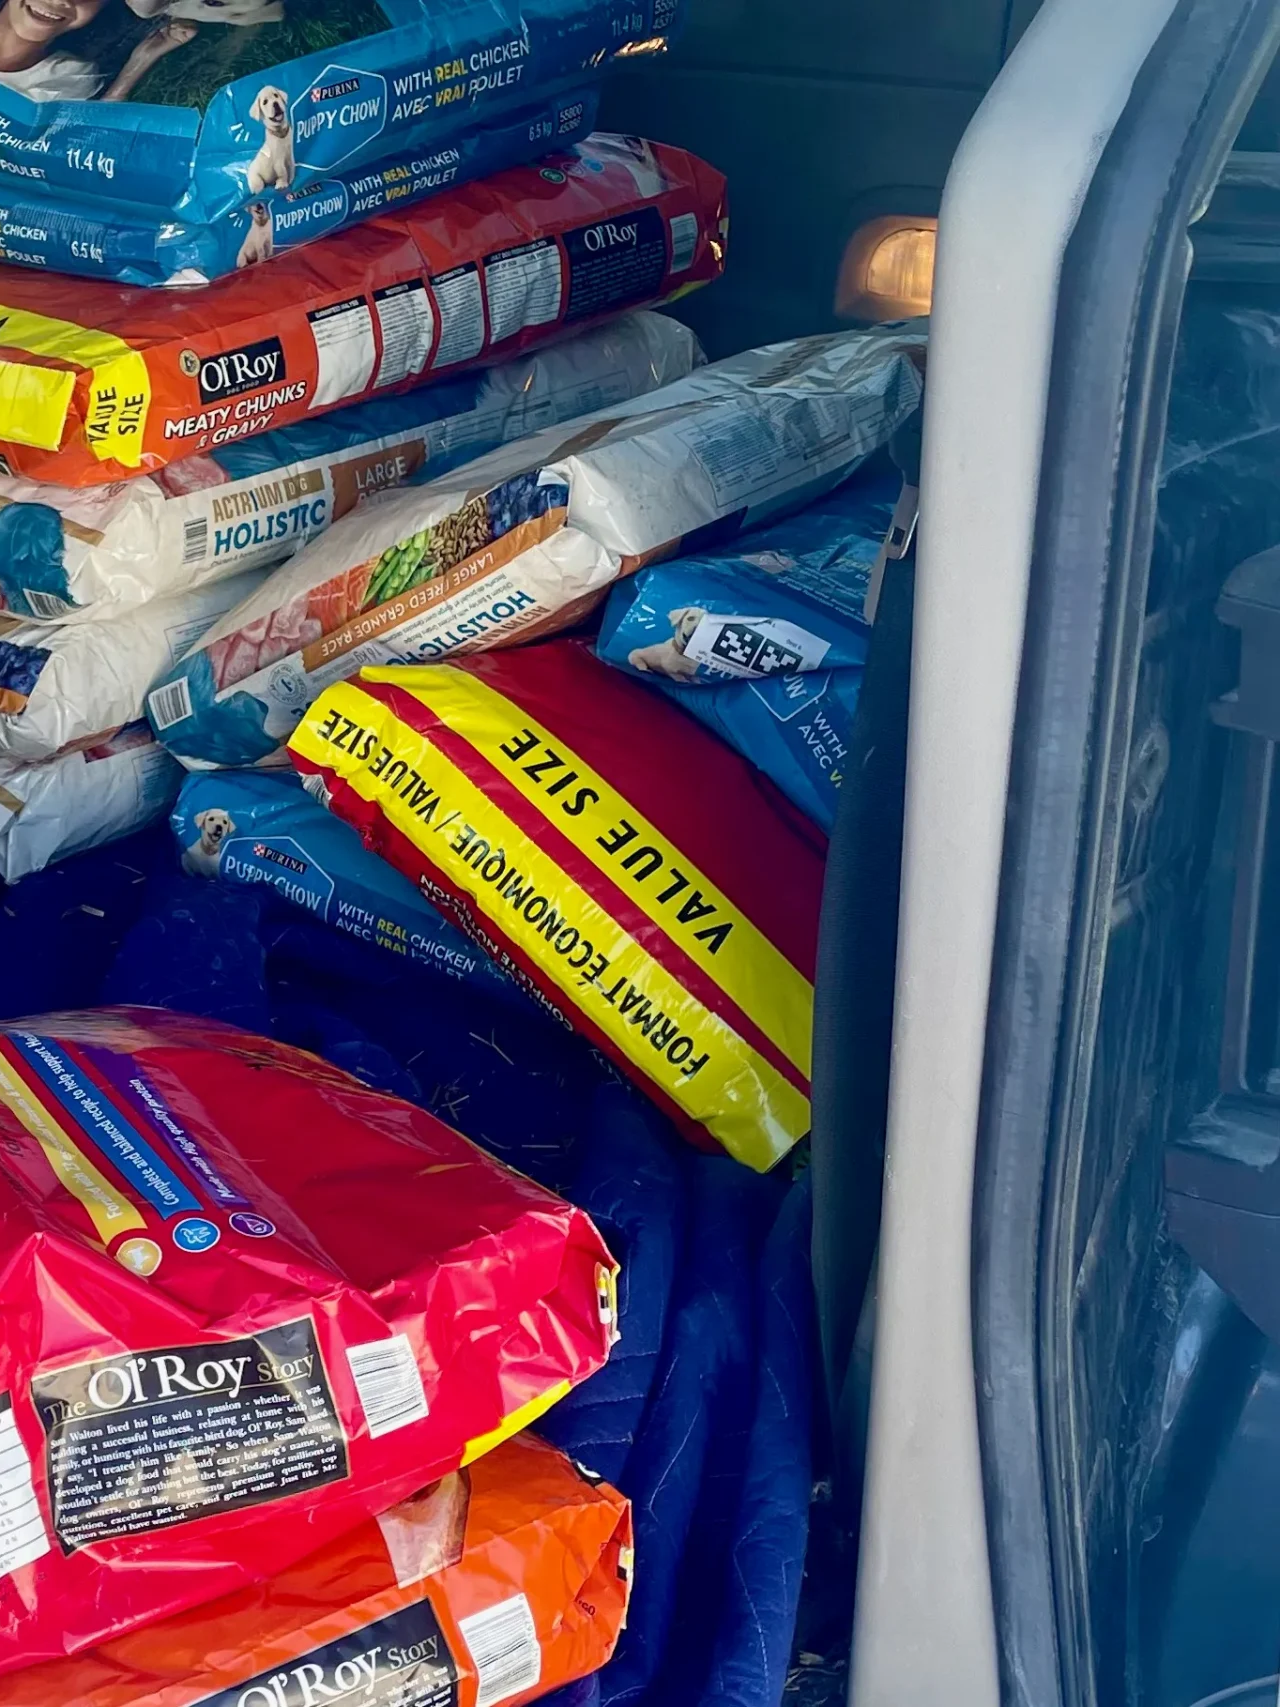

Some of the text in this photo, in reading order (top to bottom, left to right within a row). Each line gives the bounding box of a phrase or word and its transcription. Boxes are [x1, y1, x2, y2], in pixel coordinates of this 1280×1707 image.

[321, 79, 359, 98] PURINA
[393, 40, 530, 96] WITH REAL CHICKEN
[392, 64, 524, 122] AVEC VRAI POULET
[297, 98, 380, 143] PUPPY CHOW
[0, 159, 46, 180] POULET
[66, 148, 115, 179] 11.4 kg
[350, 148, 459, 195] WITH REAL CHICKEN
[276, 194, 343, 231] PUPPY CHOW
[353, 167, 458, 214] AVEC VRAI POULET
[2, 223, 47, 241] CHICKEN
[71, 241, 103, 262] 6.5 kg
[6, 250, 46, 266] POULET
[118, 393, 143, 435] SIZE
[165, 382, 307, 439] MEATY CHUNKS
[211, 416, 273, 447] GRAVY
[354, 457, 407, 488] LARGE
[212, 482, 283, 522] ACTRIUM
[215, 500, 326, 555] HOLISTIC
[322, 553, 494, 656] LARGE RACE
[317, 710, 378, 757] SIZE
[799, 724, 832, 769] AVEC
[814, 711, 847, 758] WITH
[368, 752, 436, 824] VALUE
[266, 849, 305, 871] PURINA
[499, 729, 735, 955] VALUE SIZE
[226, 856, 321, 910] PUPPY CHOW
[450, 824, 607, 994] ÉCONOMIQUE
[336, 918, 407, 956] AVEC VRAI
[339, 901, 475, 973] WITH REAL CHICKEN
[605, 978, 710, 1082] FORMAT
[34, 1047, 180, 1206] Complete and balanced recipe to help support
[44, 1397, 87, 1426] The
[257, 1352, 314, 1382] Story
[69, 1392, 291, 1441] Walton lived his life with passion whether
[102, 1397, 325, 1449] successful business, relaxing at home with his
[387, 1633, 440, 1671] Story
